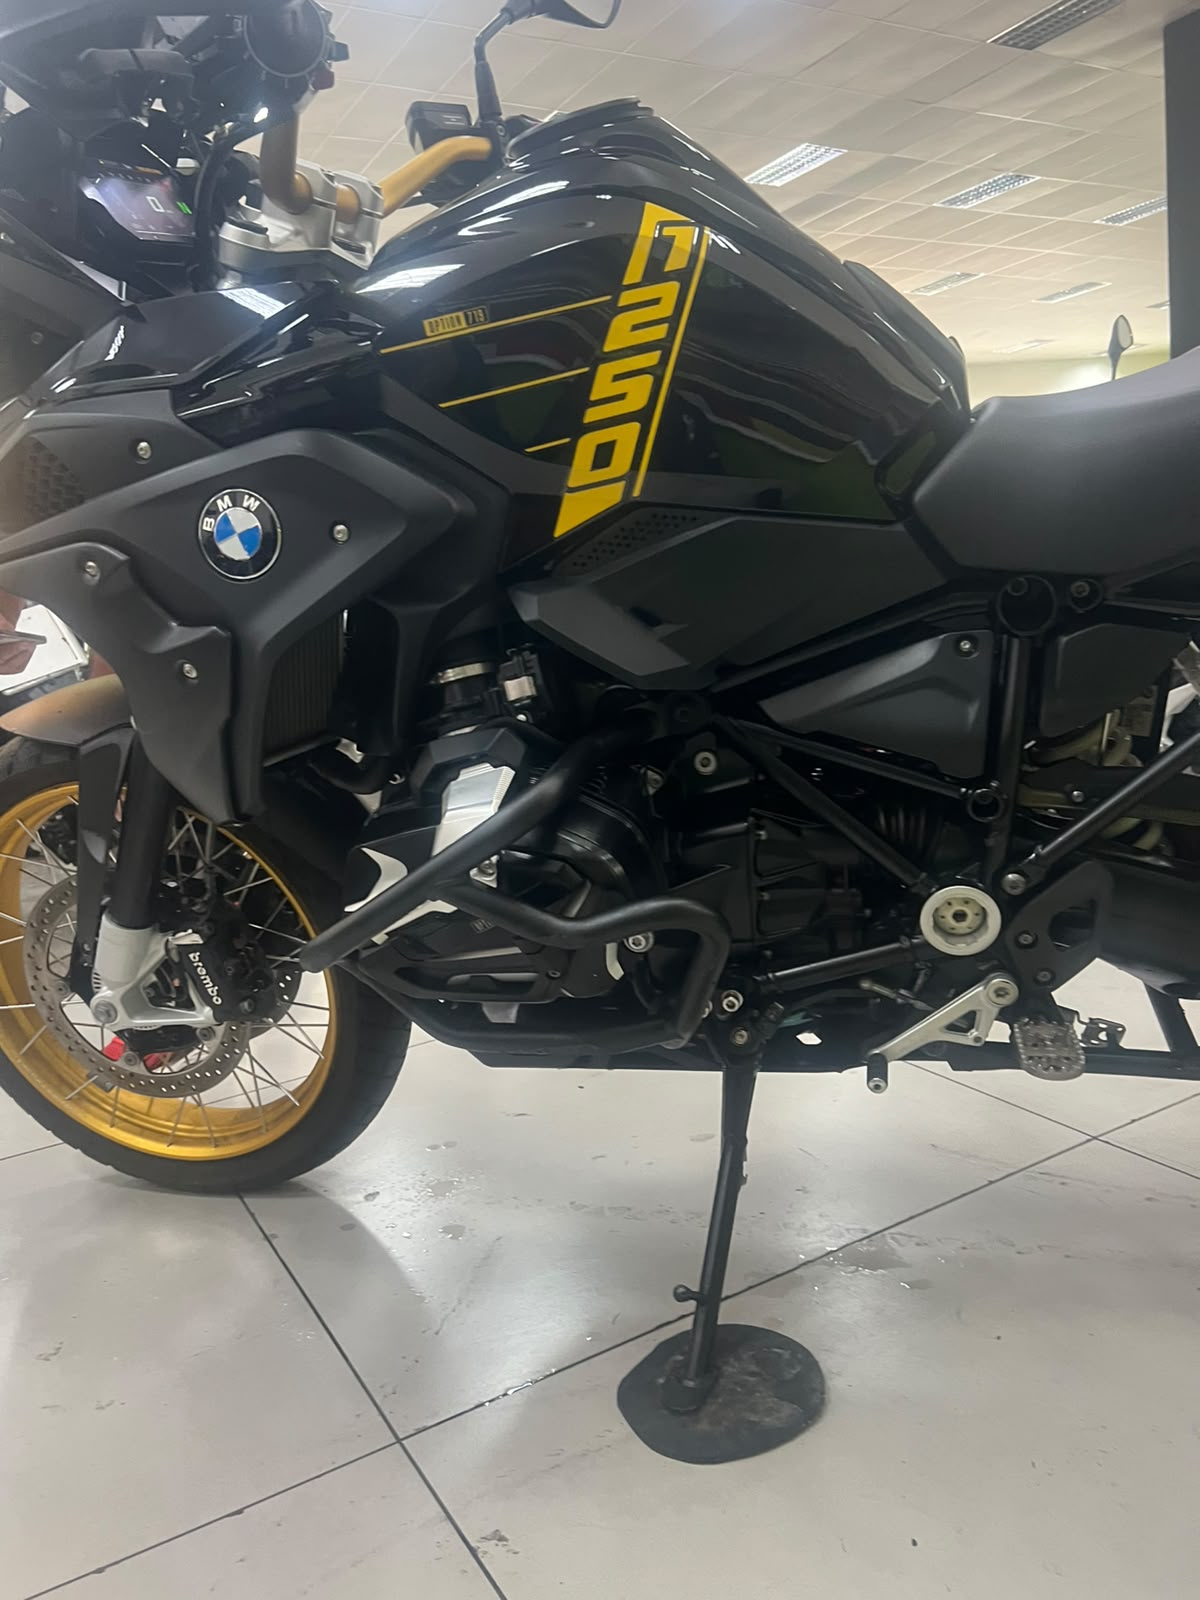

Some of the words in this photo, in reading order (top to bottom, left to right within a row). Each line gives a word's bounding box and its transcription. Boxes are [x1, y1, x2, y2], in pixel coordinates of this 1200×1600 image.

[427, 314, 463, 334] OPTION
[466, 309, 486, 326] 719
[566, 224, 697, 488] 1250
[202, 494, 261, 532] BMW
[188, 951, 222, 1005] brembo
